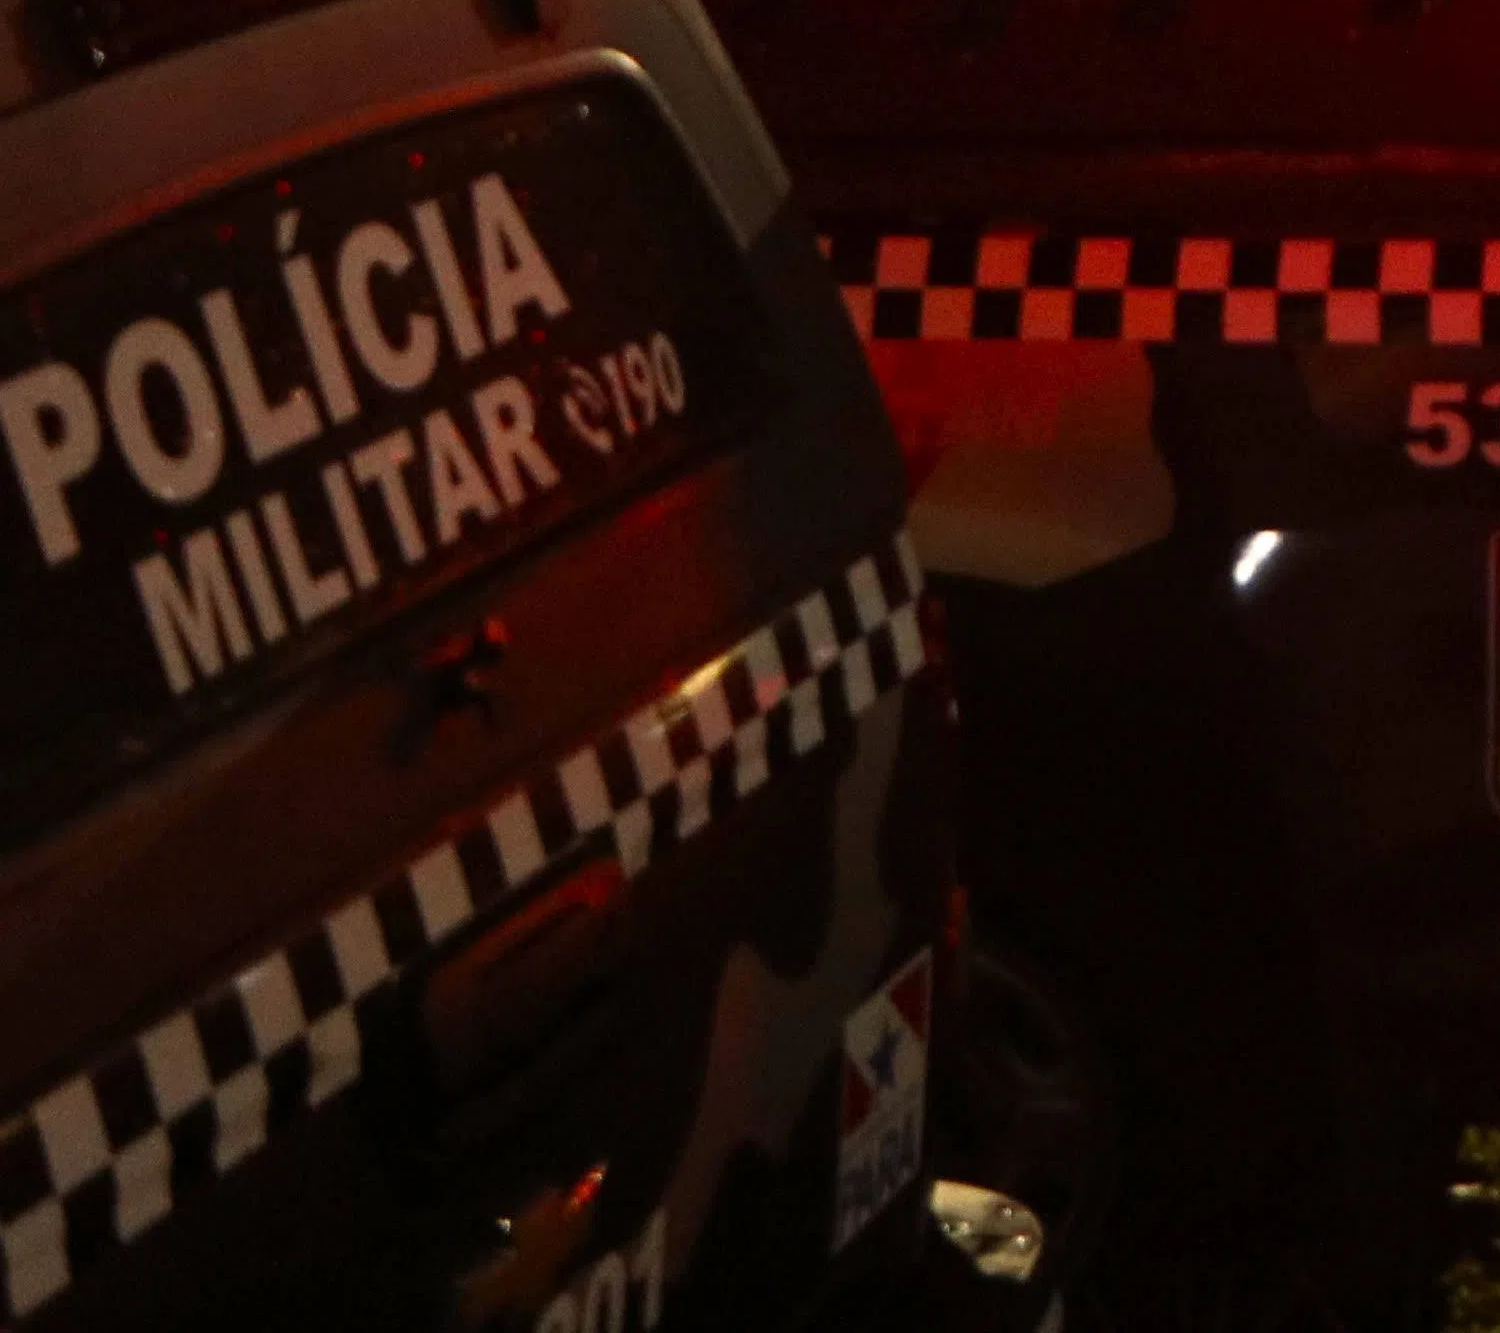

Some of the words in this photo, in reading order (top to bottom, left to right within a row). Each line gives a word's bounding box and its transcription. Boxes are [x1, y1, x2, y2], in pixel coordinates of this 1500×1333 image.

[0, 171, 574, 570] POLÍCIA
[130, 374, 562, 697] MILITAR
[600, 330, 687, 436] 190
